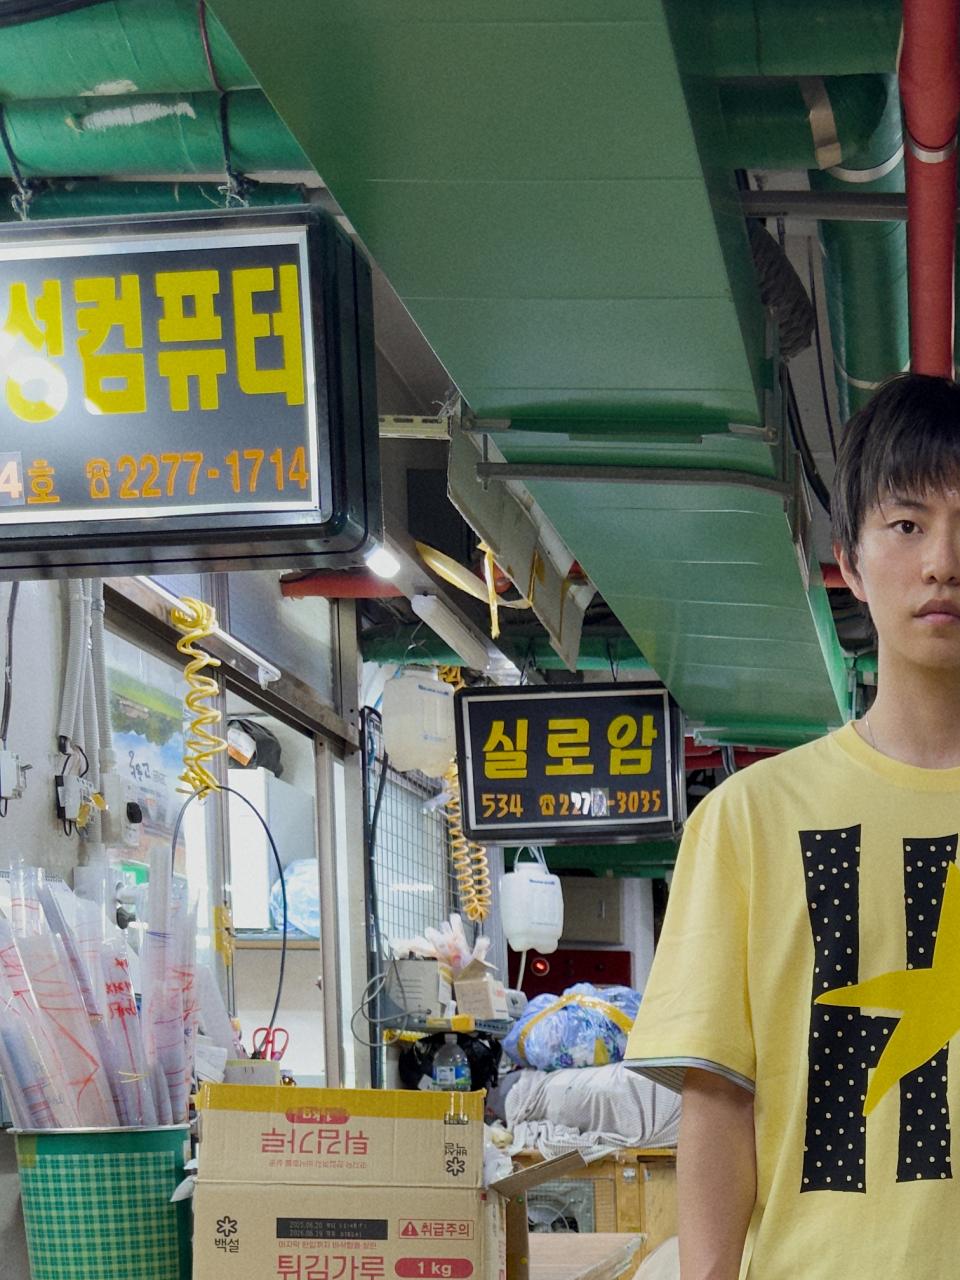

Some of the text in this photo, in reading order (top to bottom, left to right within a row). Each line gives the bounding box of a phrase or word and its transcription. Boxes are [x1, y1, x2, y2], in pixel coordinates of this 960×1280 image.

[118, 446, 309, 499] 2277-1714
[482, 713, 658, 780] 실로암
[481, 792, 524, 818] 534
[261, 1127, 370, 1156] 튀김가루
[421, 1222, 470, 1237] 취급주의
[214, 1237, 240, 1253] 백설
[418, 1261, 452, 1277] 1 kg
